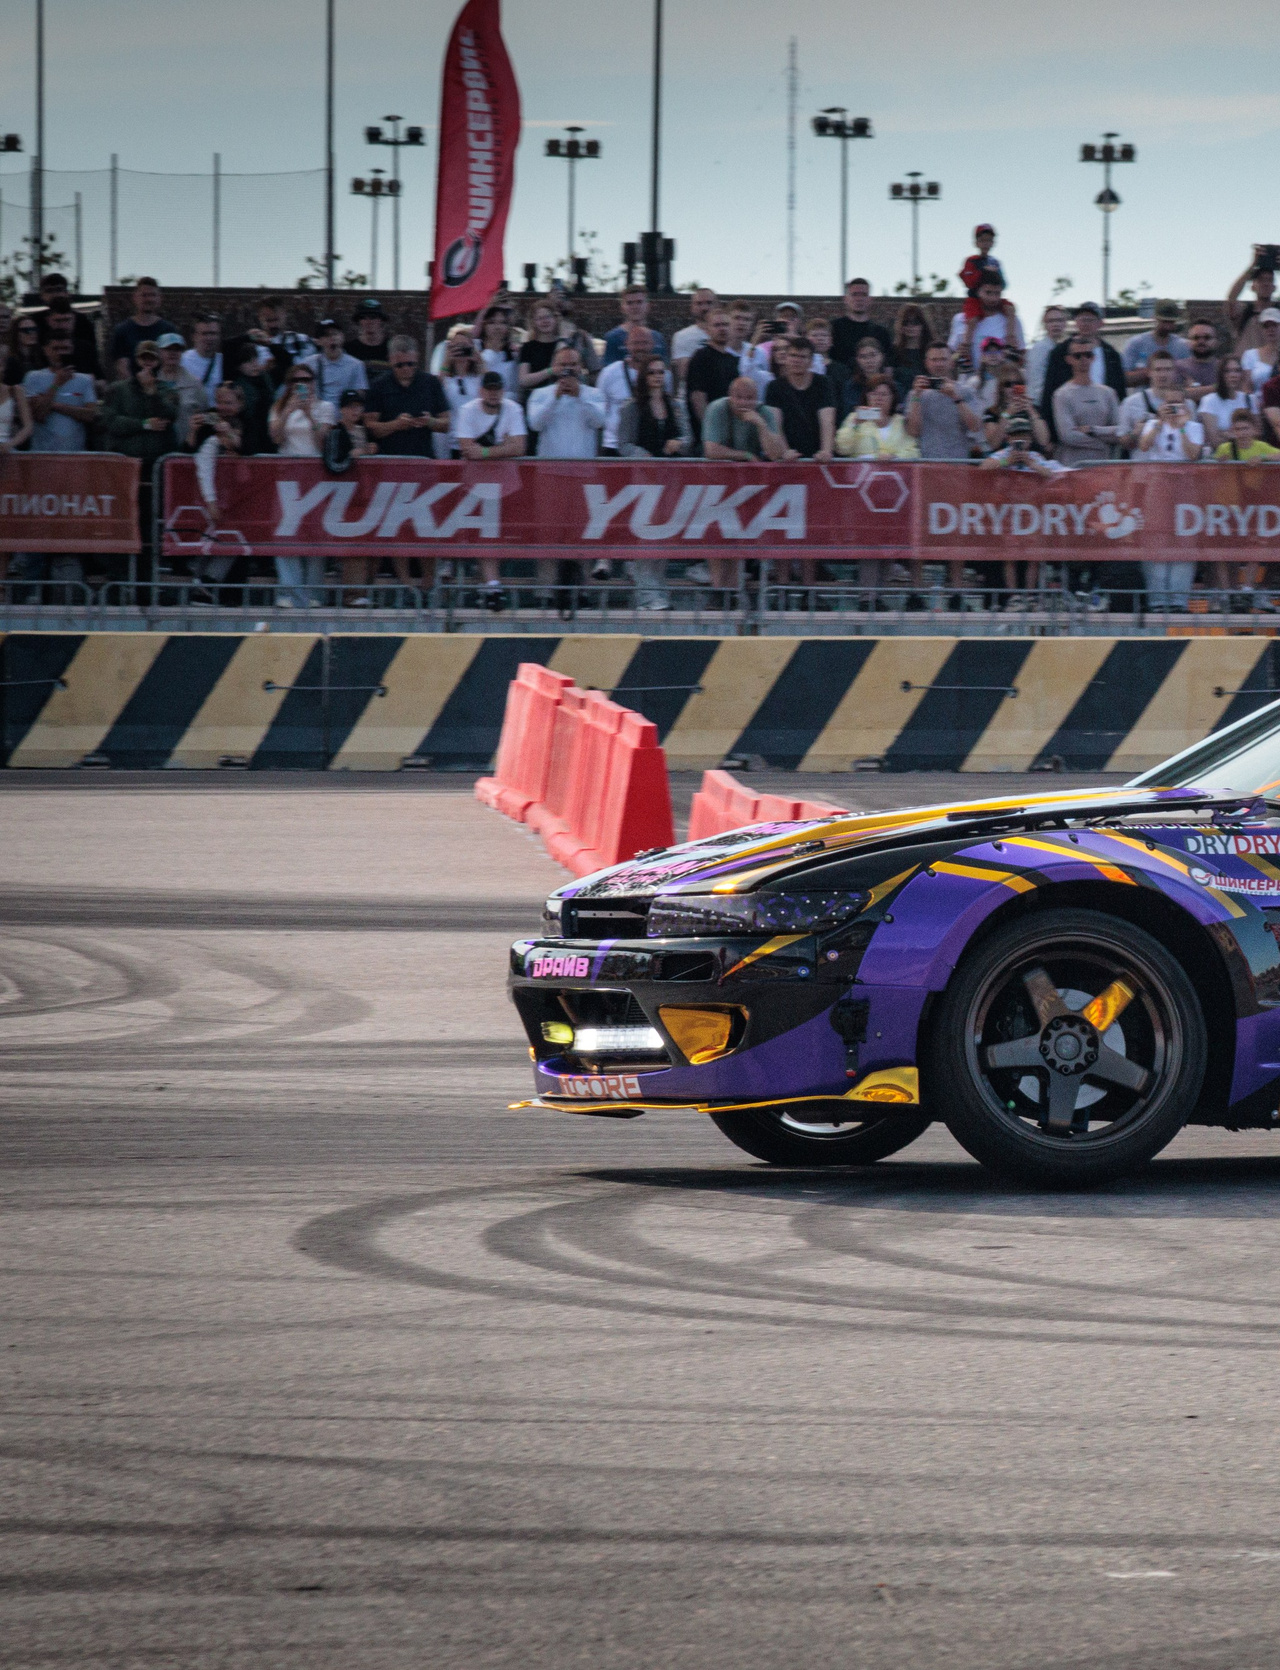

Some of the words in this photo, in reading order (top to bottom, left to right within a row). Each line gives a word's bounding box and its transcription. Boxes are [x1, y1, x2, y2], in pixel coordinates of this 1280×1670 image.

[273, 481, 501, 539] YUKA
[581, 483, 808, 540] YUKA
[928, 502, 1095, 536] DRYDRY
